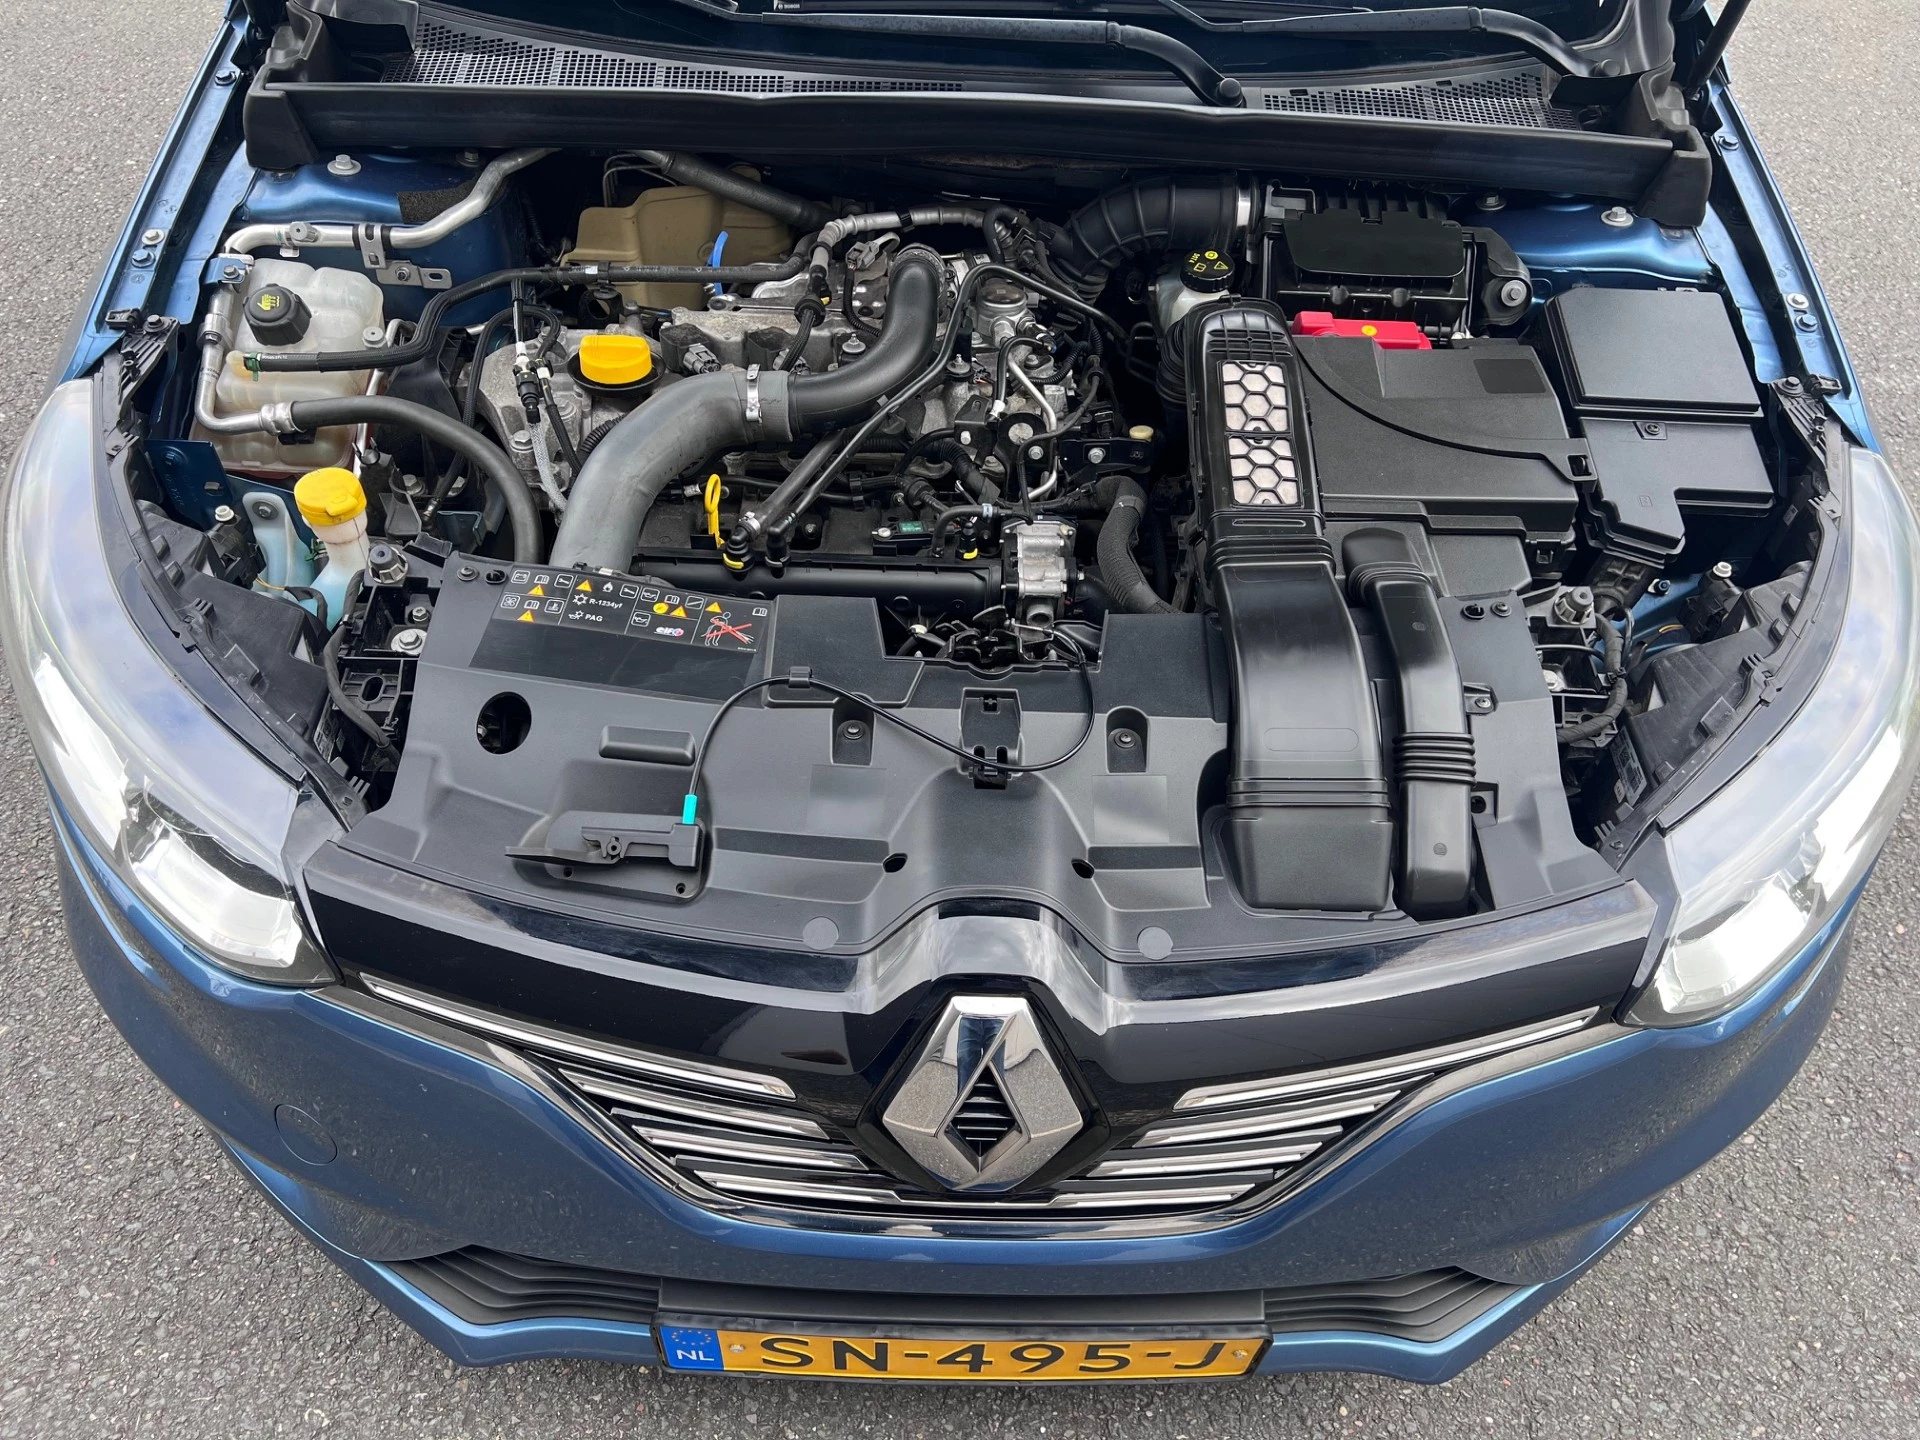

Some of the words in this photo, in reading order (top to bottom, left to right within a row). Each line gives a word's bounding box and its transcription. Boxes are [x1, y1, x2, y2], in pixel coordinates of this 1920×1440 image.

[589, 598, 623, 609] R-1234yf
[585, 613, 603, 622] PAG
[676, 1349, 715, 1362] NL
[760, 1337, 1227, 1373] SN-495-J
